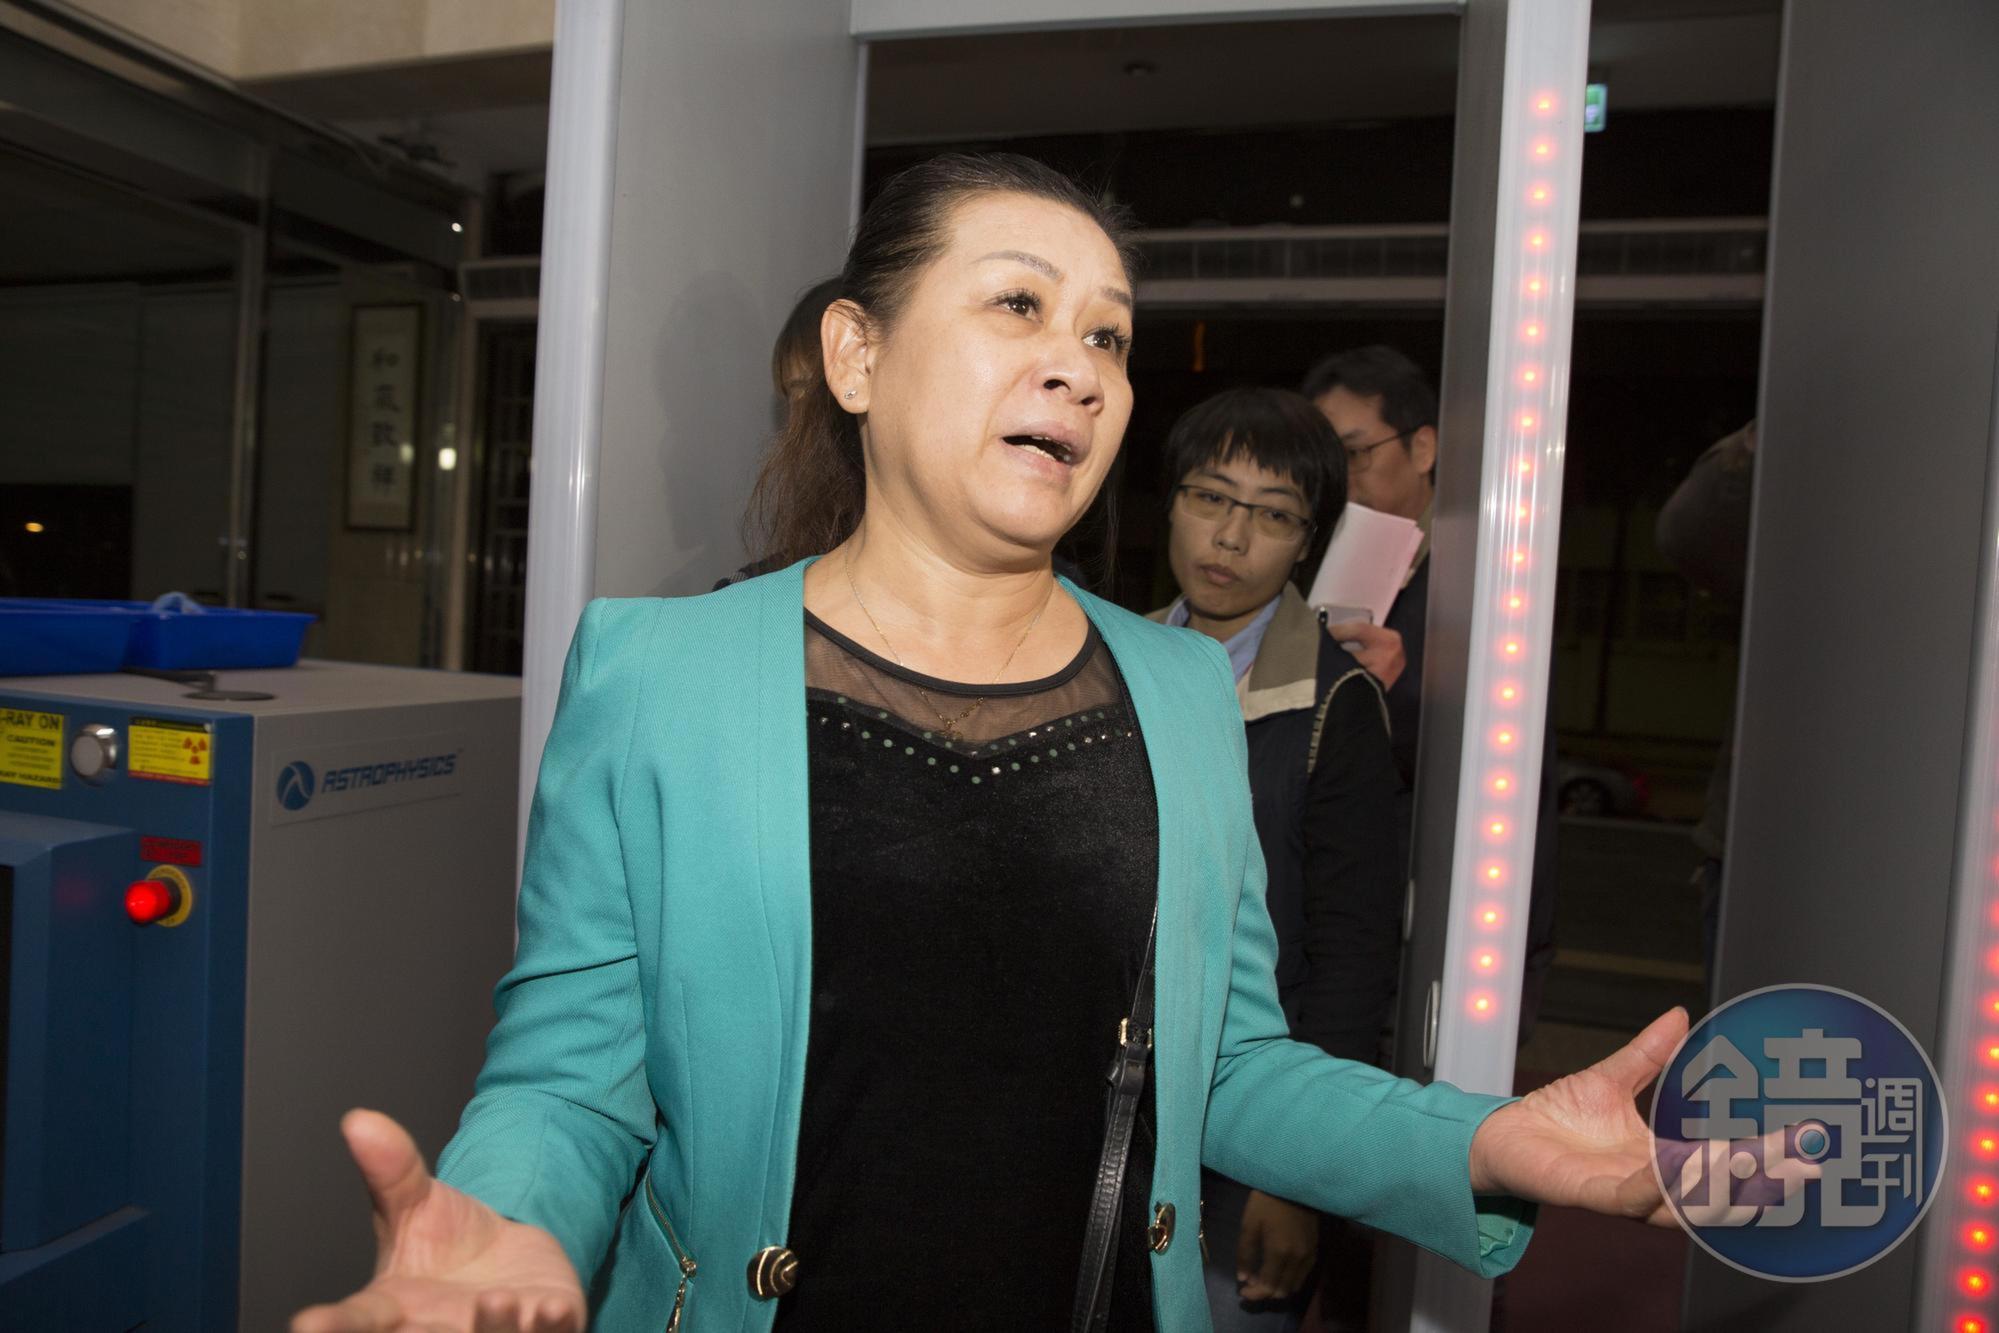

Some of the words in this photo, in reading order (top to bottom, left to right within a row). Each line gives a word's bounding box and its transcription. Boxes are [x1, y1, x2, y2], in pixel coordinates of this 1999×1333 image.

[38, 715, 59, 730] ON
[7, 734, 56, 747] CAUTION
[321, 752, 457, 793] ASTROPHYSICS
